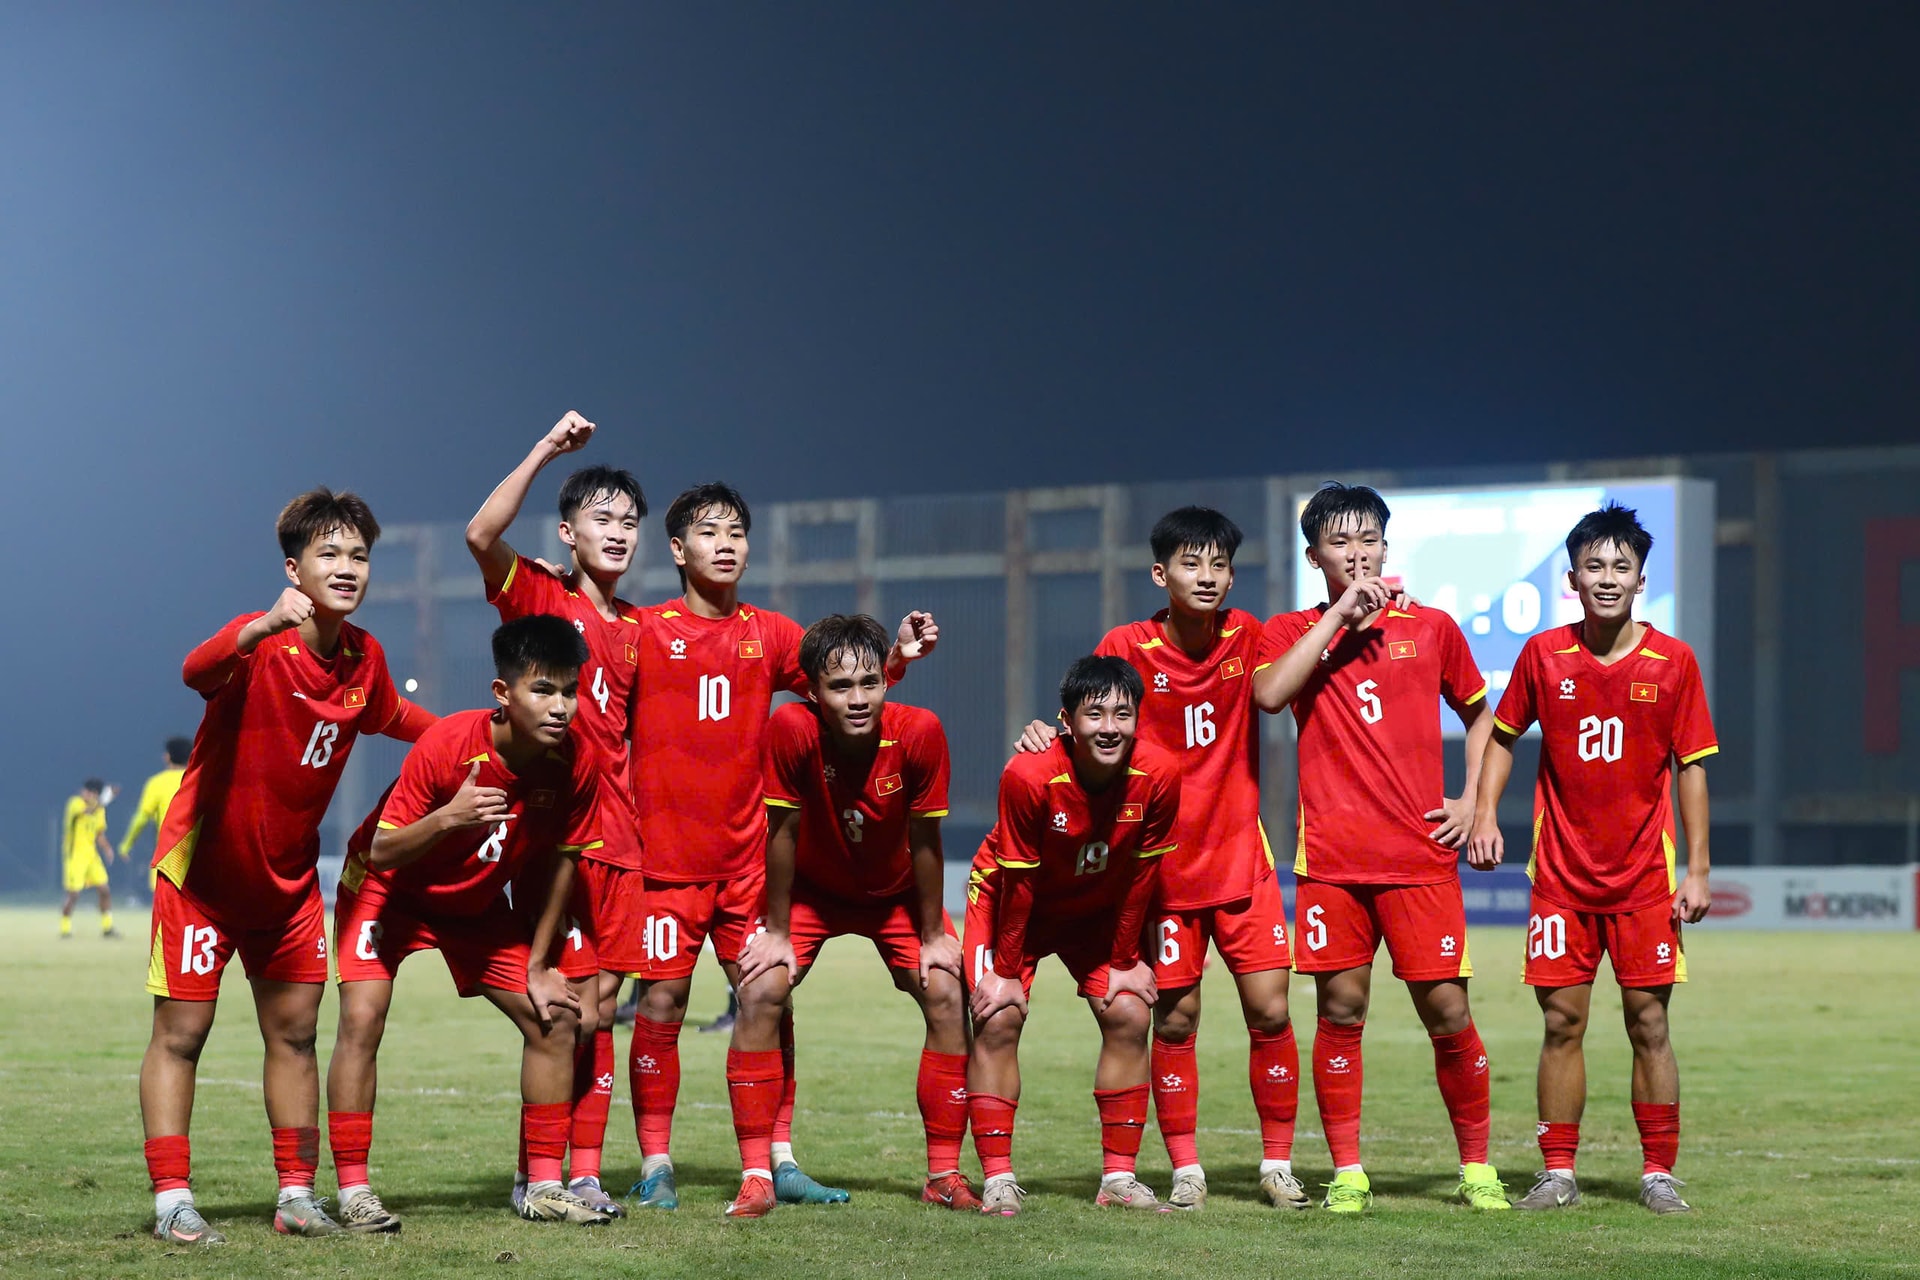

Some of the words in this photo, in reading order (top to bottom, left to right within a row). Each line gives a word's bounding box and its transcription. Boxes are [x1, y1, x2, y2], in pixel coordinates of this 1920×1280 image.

[592, 667, 610, 714] 4
[698, 674, 730, 721] 10
[1356, 679, 1383, 725] 5
[300, 720, 339, 768] 13
[1184, 702, 1216, 748] 16
[1578, 715, 1624, 763] 20
[477, 820, 508, 863] 8
[843, 809, 864, 842] 3
[1074, 841, 1109, 877] 19
[181, 924, 218, 976] 13
[355, 920, 384, 961] 8
[646, 914, 678, 961] 10
[1306, 904, 1328, 952] 5
[1529, 912, 1567, 960] 20
